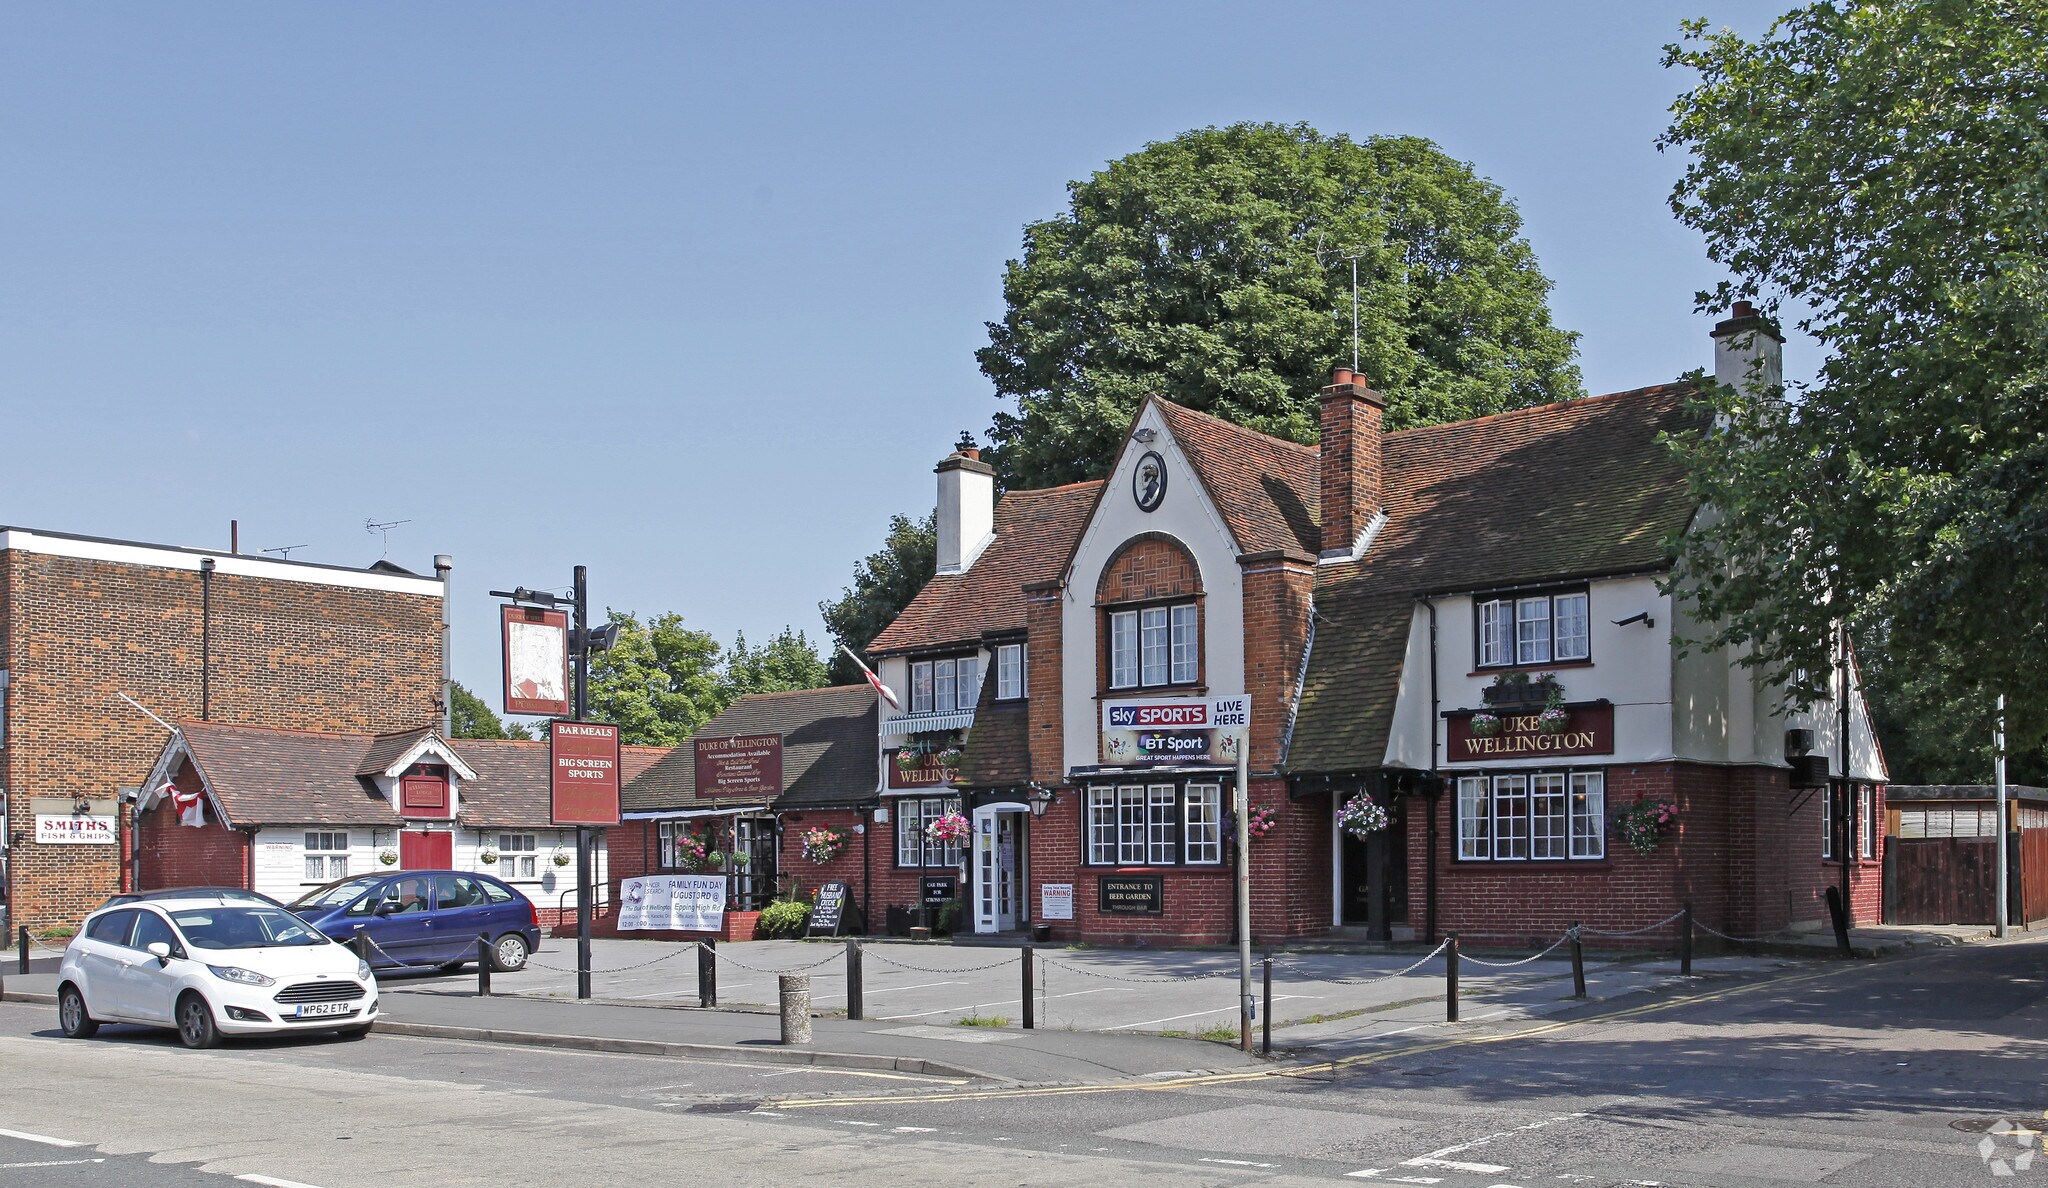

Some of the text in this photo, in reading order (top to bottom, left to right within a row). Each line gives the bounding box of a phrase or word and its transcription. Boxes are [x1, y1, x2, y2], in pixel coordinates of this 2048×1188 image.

[1216, 700, 1242, 713] LIVE
[1112, 707, 1203, 724] sky SPORTS
[1214, 713, 1245, 725] HERE
[1503, 715, 1540, 733] UKE
[559, 725, 613, 737] BAR MEALS
[699, 737, 778, 751] DUKE OF WELLINGTON
[1145, 736, 1203, 751] BT Sport
[1465, 731, 1595, 754] WELLINGTON
[559, 758, 613, 768] BIG SCREEN
[568, 769, 604, 779] SPORTS
[44, 820, 108, 831] SMITHS
[669, 880, 723, 889] FAMILY FUN DAY
[712, 892, 720, 902] @
[820, 891, 842, 899] HUSBAND
[649, 904, 672, 912] Wellingto
[675, 903, 695, 912] Epping
[696, 903, 710, 912] High
[712, 903, 721, 911] Rd
[304, 1003, 349, 1015] WP62 ETR
